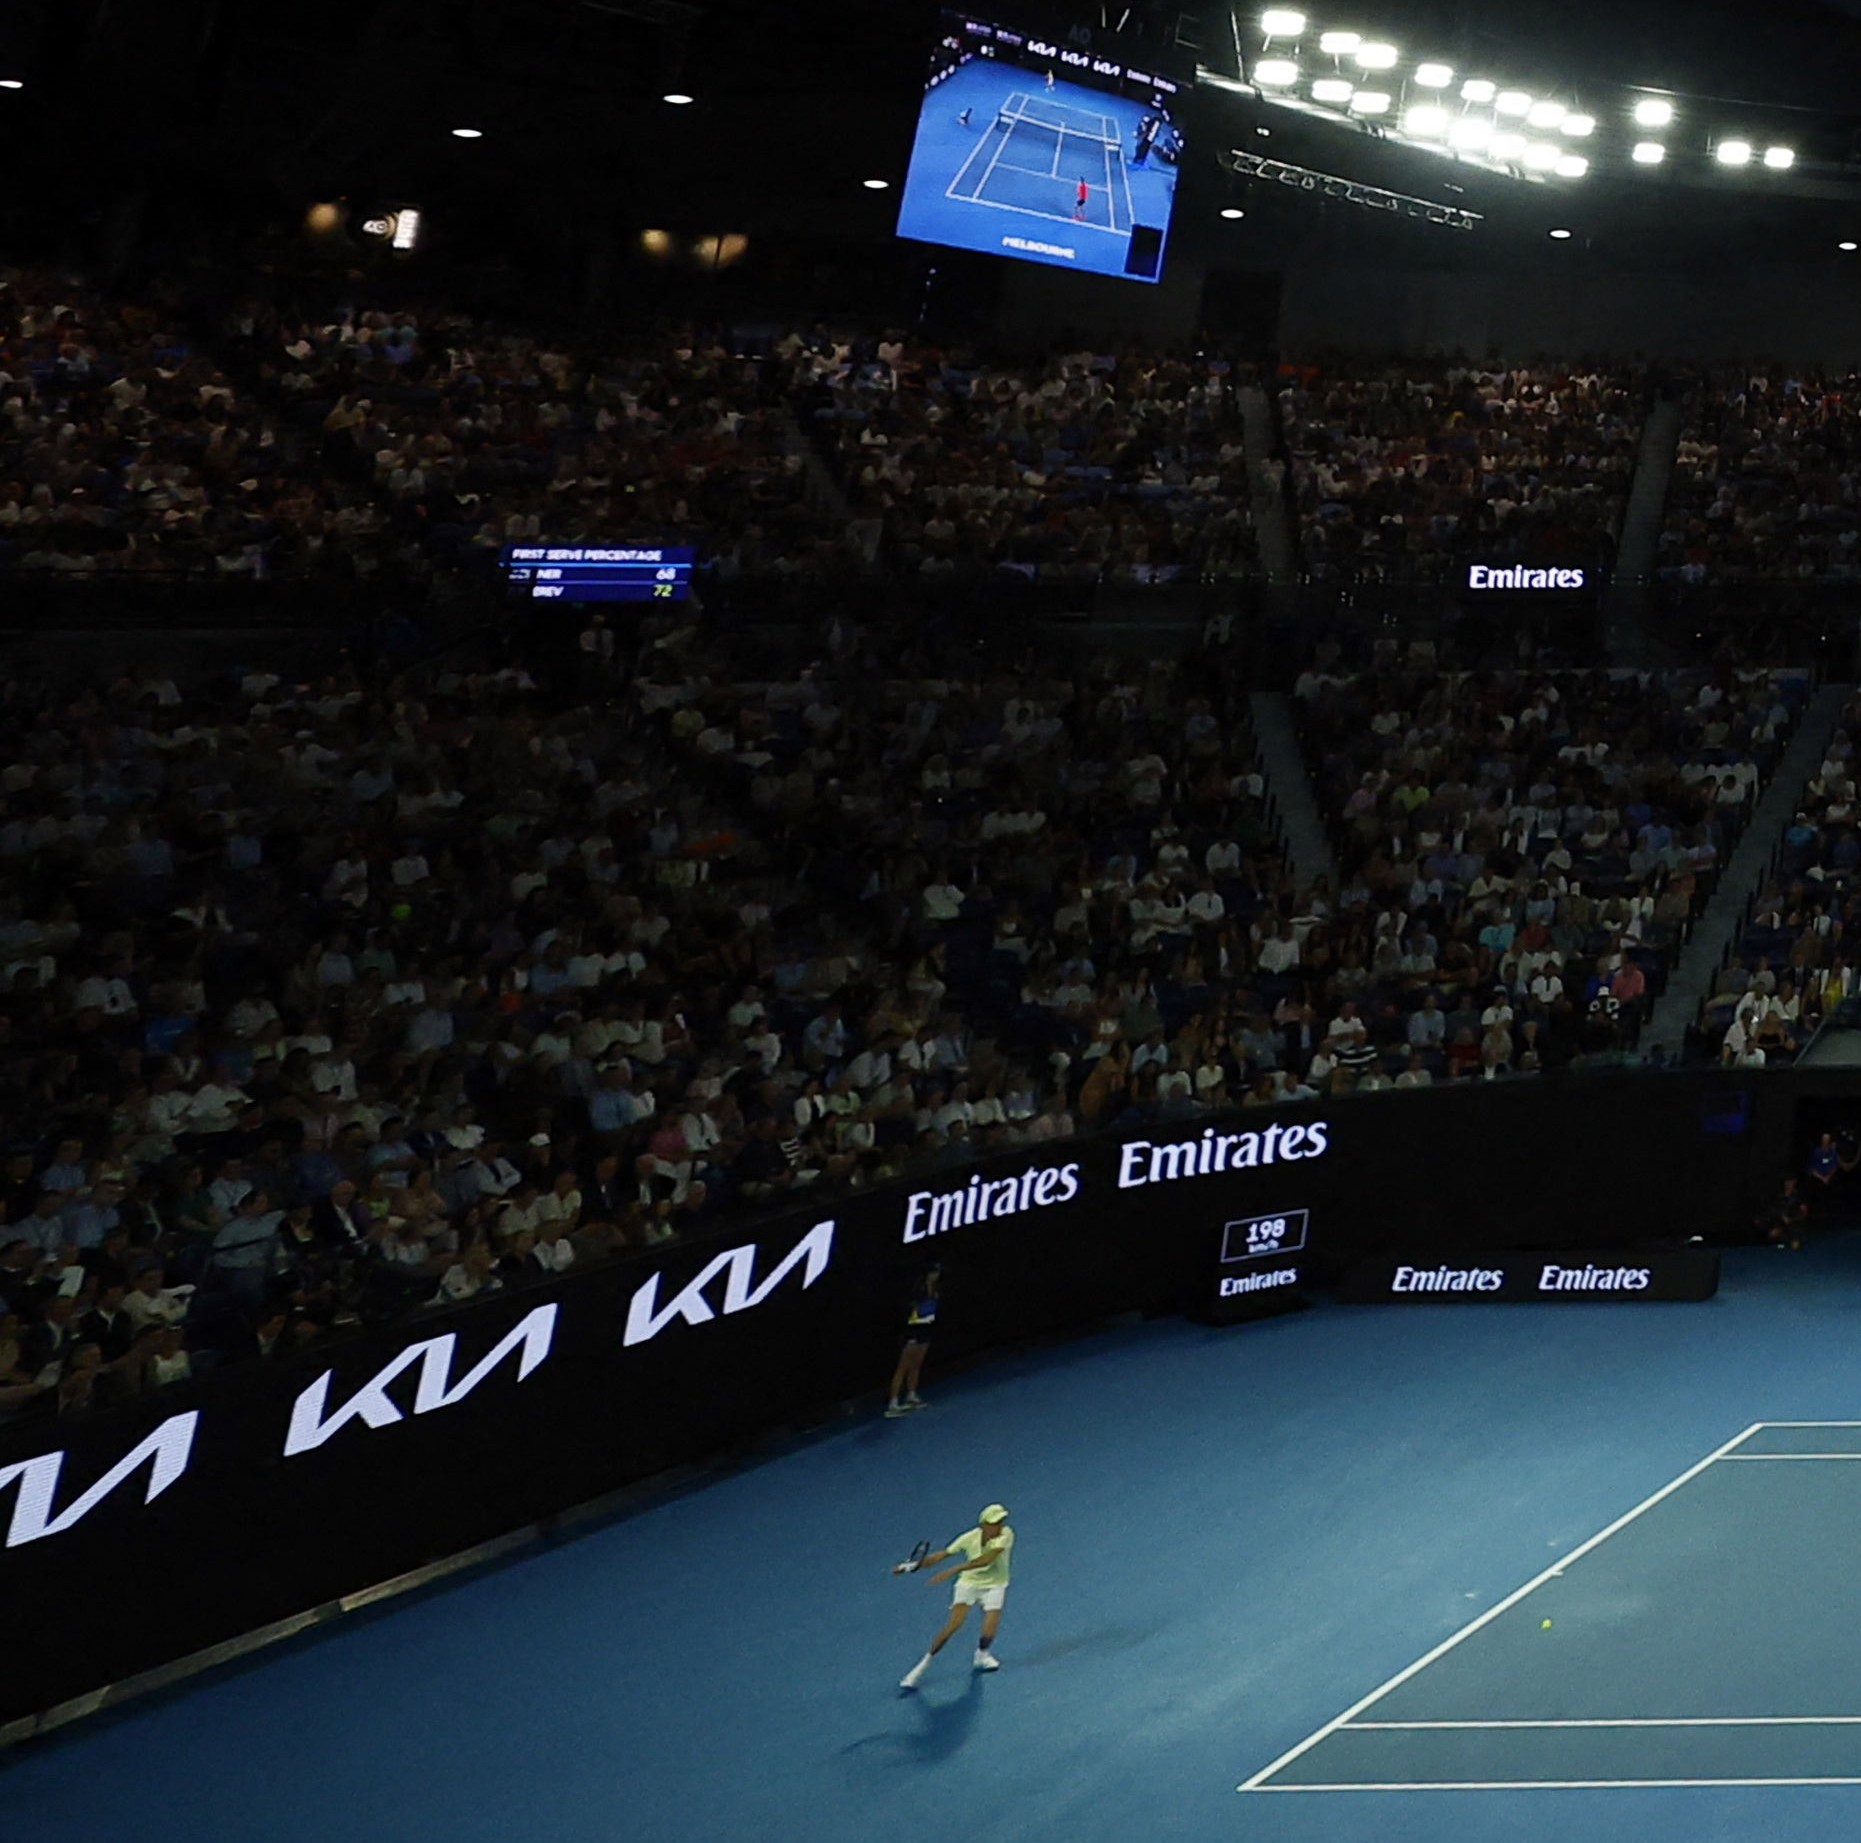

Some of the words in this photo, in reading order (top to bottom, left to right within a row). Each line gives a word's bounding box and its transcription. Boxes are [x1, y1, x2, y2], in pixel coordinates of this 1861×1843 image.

[512, 549, 545, 560] FIRST
[546, 549, 582, 561] SERVE
[584, 549, 663, 561] PERCENTAGE
[1470, 564, 1583, 588] Emirates
[653, 584, 673, 597] 72
[1119, 1122, 1327, 1188] Emirates
[903, 1164, 1079, 1243] Emirates
[1245, 1218, 1286, 1244] 198
[1220, 1268, 1297, 1296] Emirates
[1392, 1266, 1503, 1291] Emirates
[1539, 1264, 1650, 1290] Emirates
